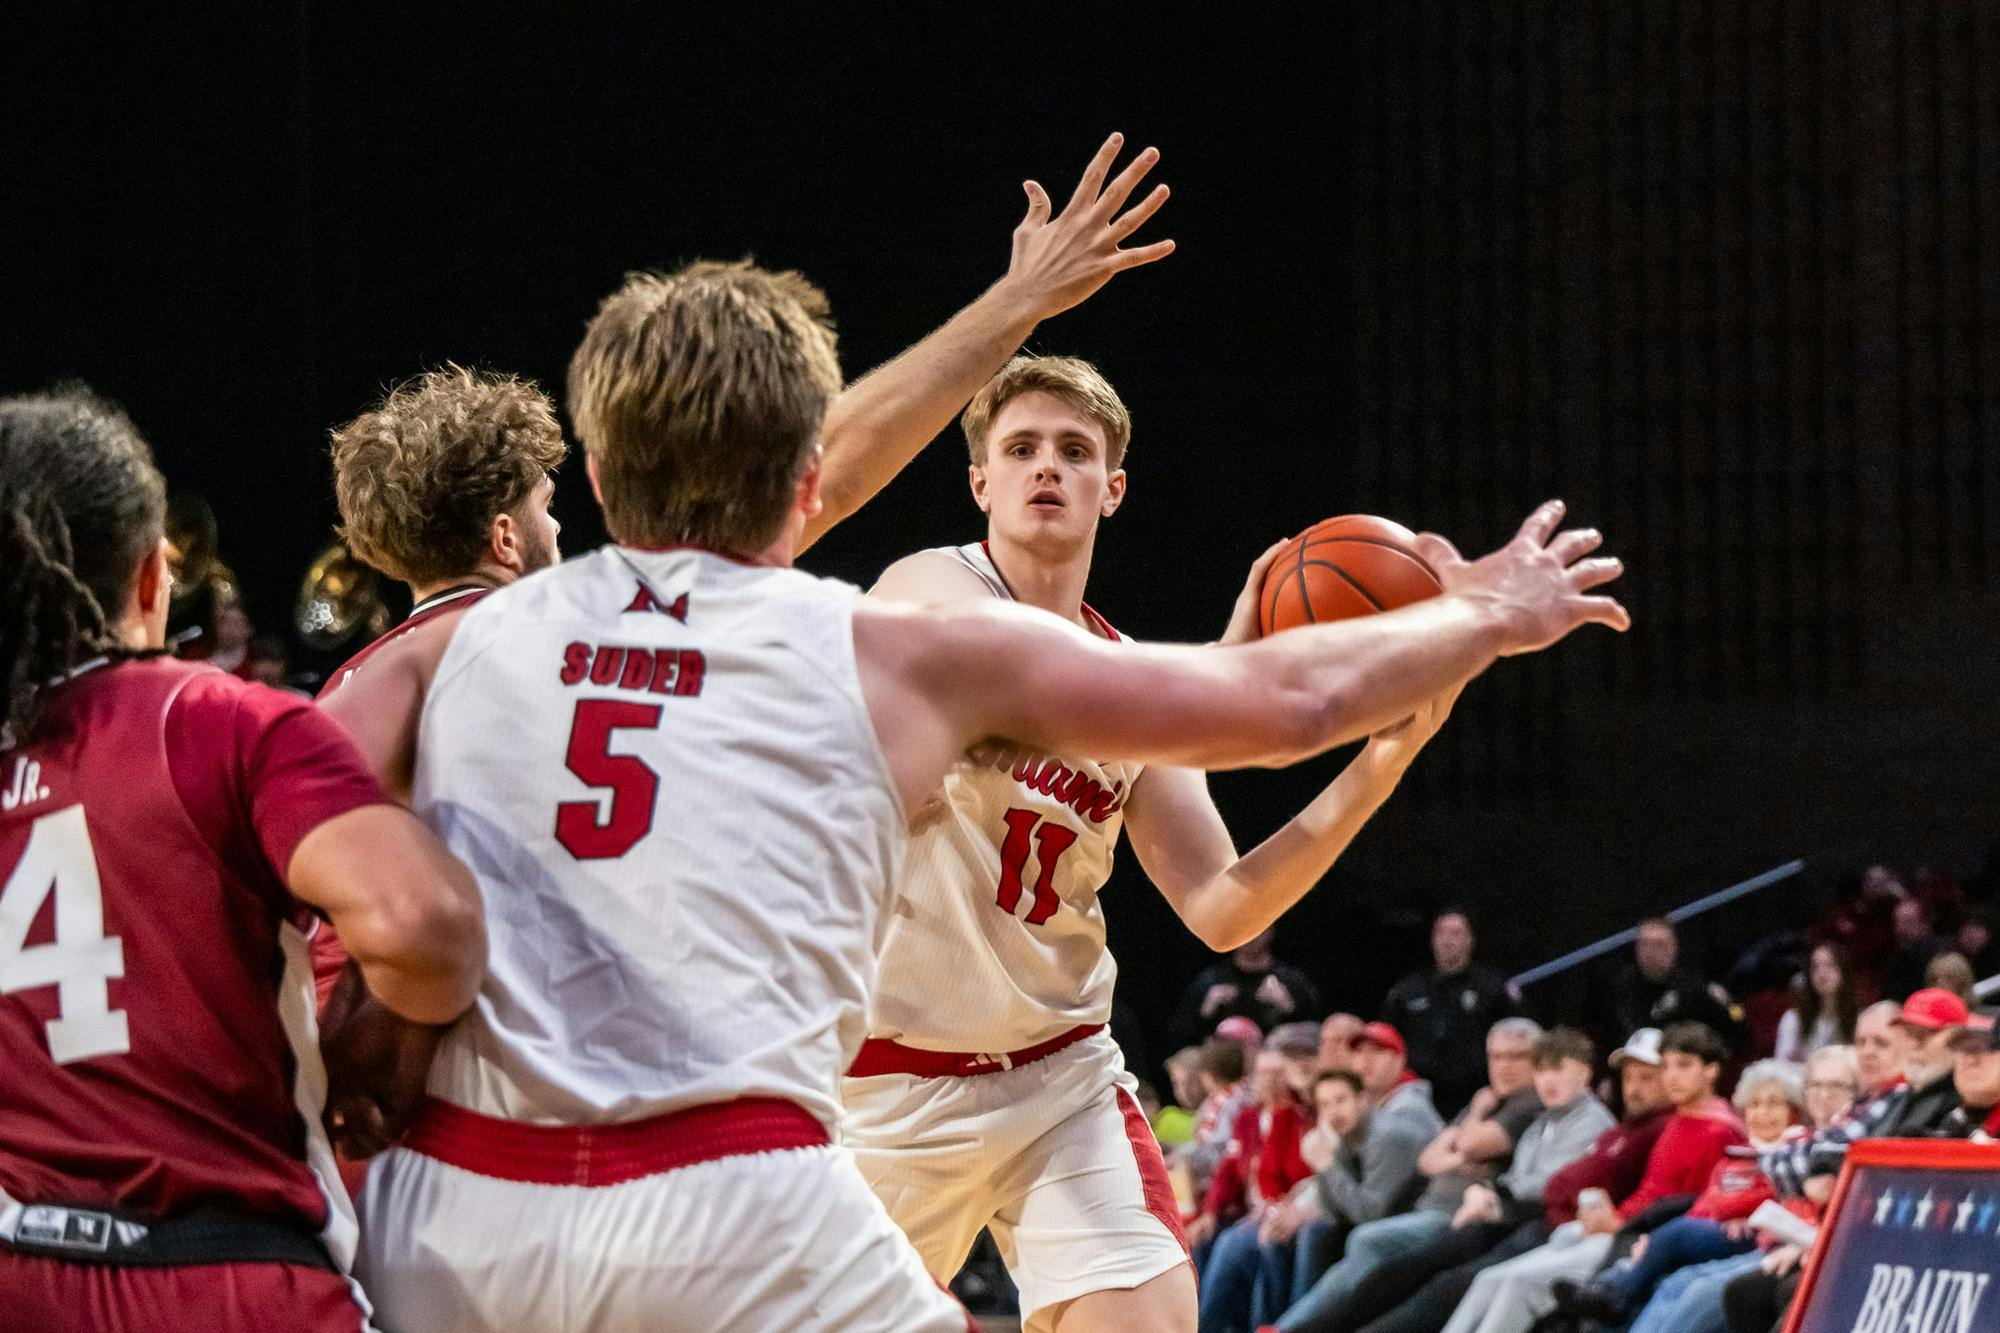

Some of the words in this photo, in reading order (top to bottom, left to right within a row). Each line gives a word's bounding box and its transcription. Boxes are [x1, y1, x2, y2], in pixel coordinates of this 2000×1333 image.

[560, 640, 707, 698] SUDER
[1, 756, 51, 811] JR.
[554, 698, 664, 861] 5
[995, 807, 1079, 926] 11
[0, 803, 131, 1064] 4
[1851, 1263, 1990, 1333] BRAUN
